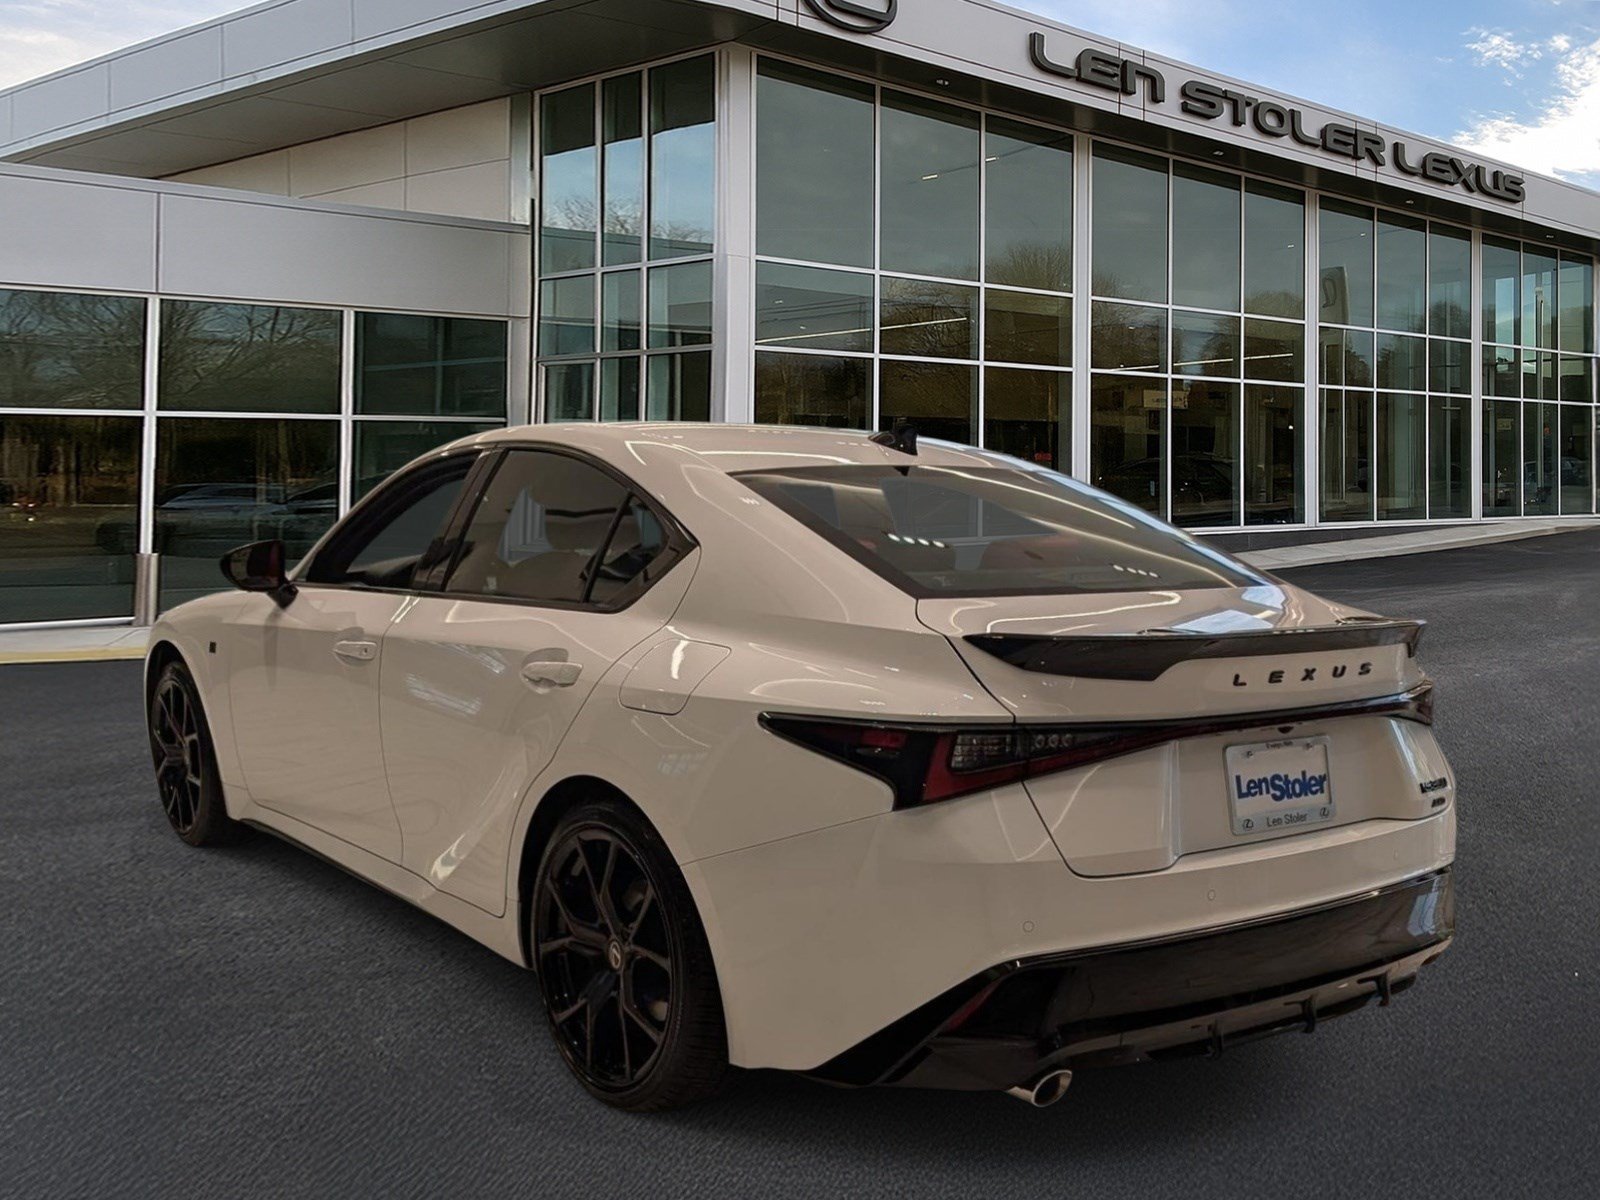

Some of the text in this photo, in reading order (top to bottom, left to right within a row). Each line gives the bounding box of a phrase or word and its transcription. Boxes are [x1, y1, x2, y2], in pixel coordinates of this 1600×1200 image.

[1029, 32, 1526, 202] LEN STOLER LEXUS
[1233, 662, 1373, 687] LEXUS
[1266, 812, 1308, 828] Len Stoler
